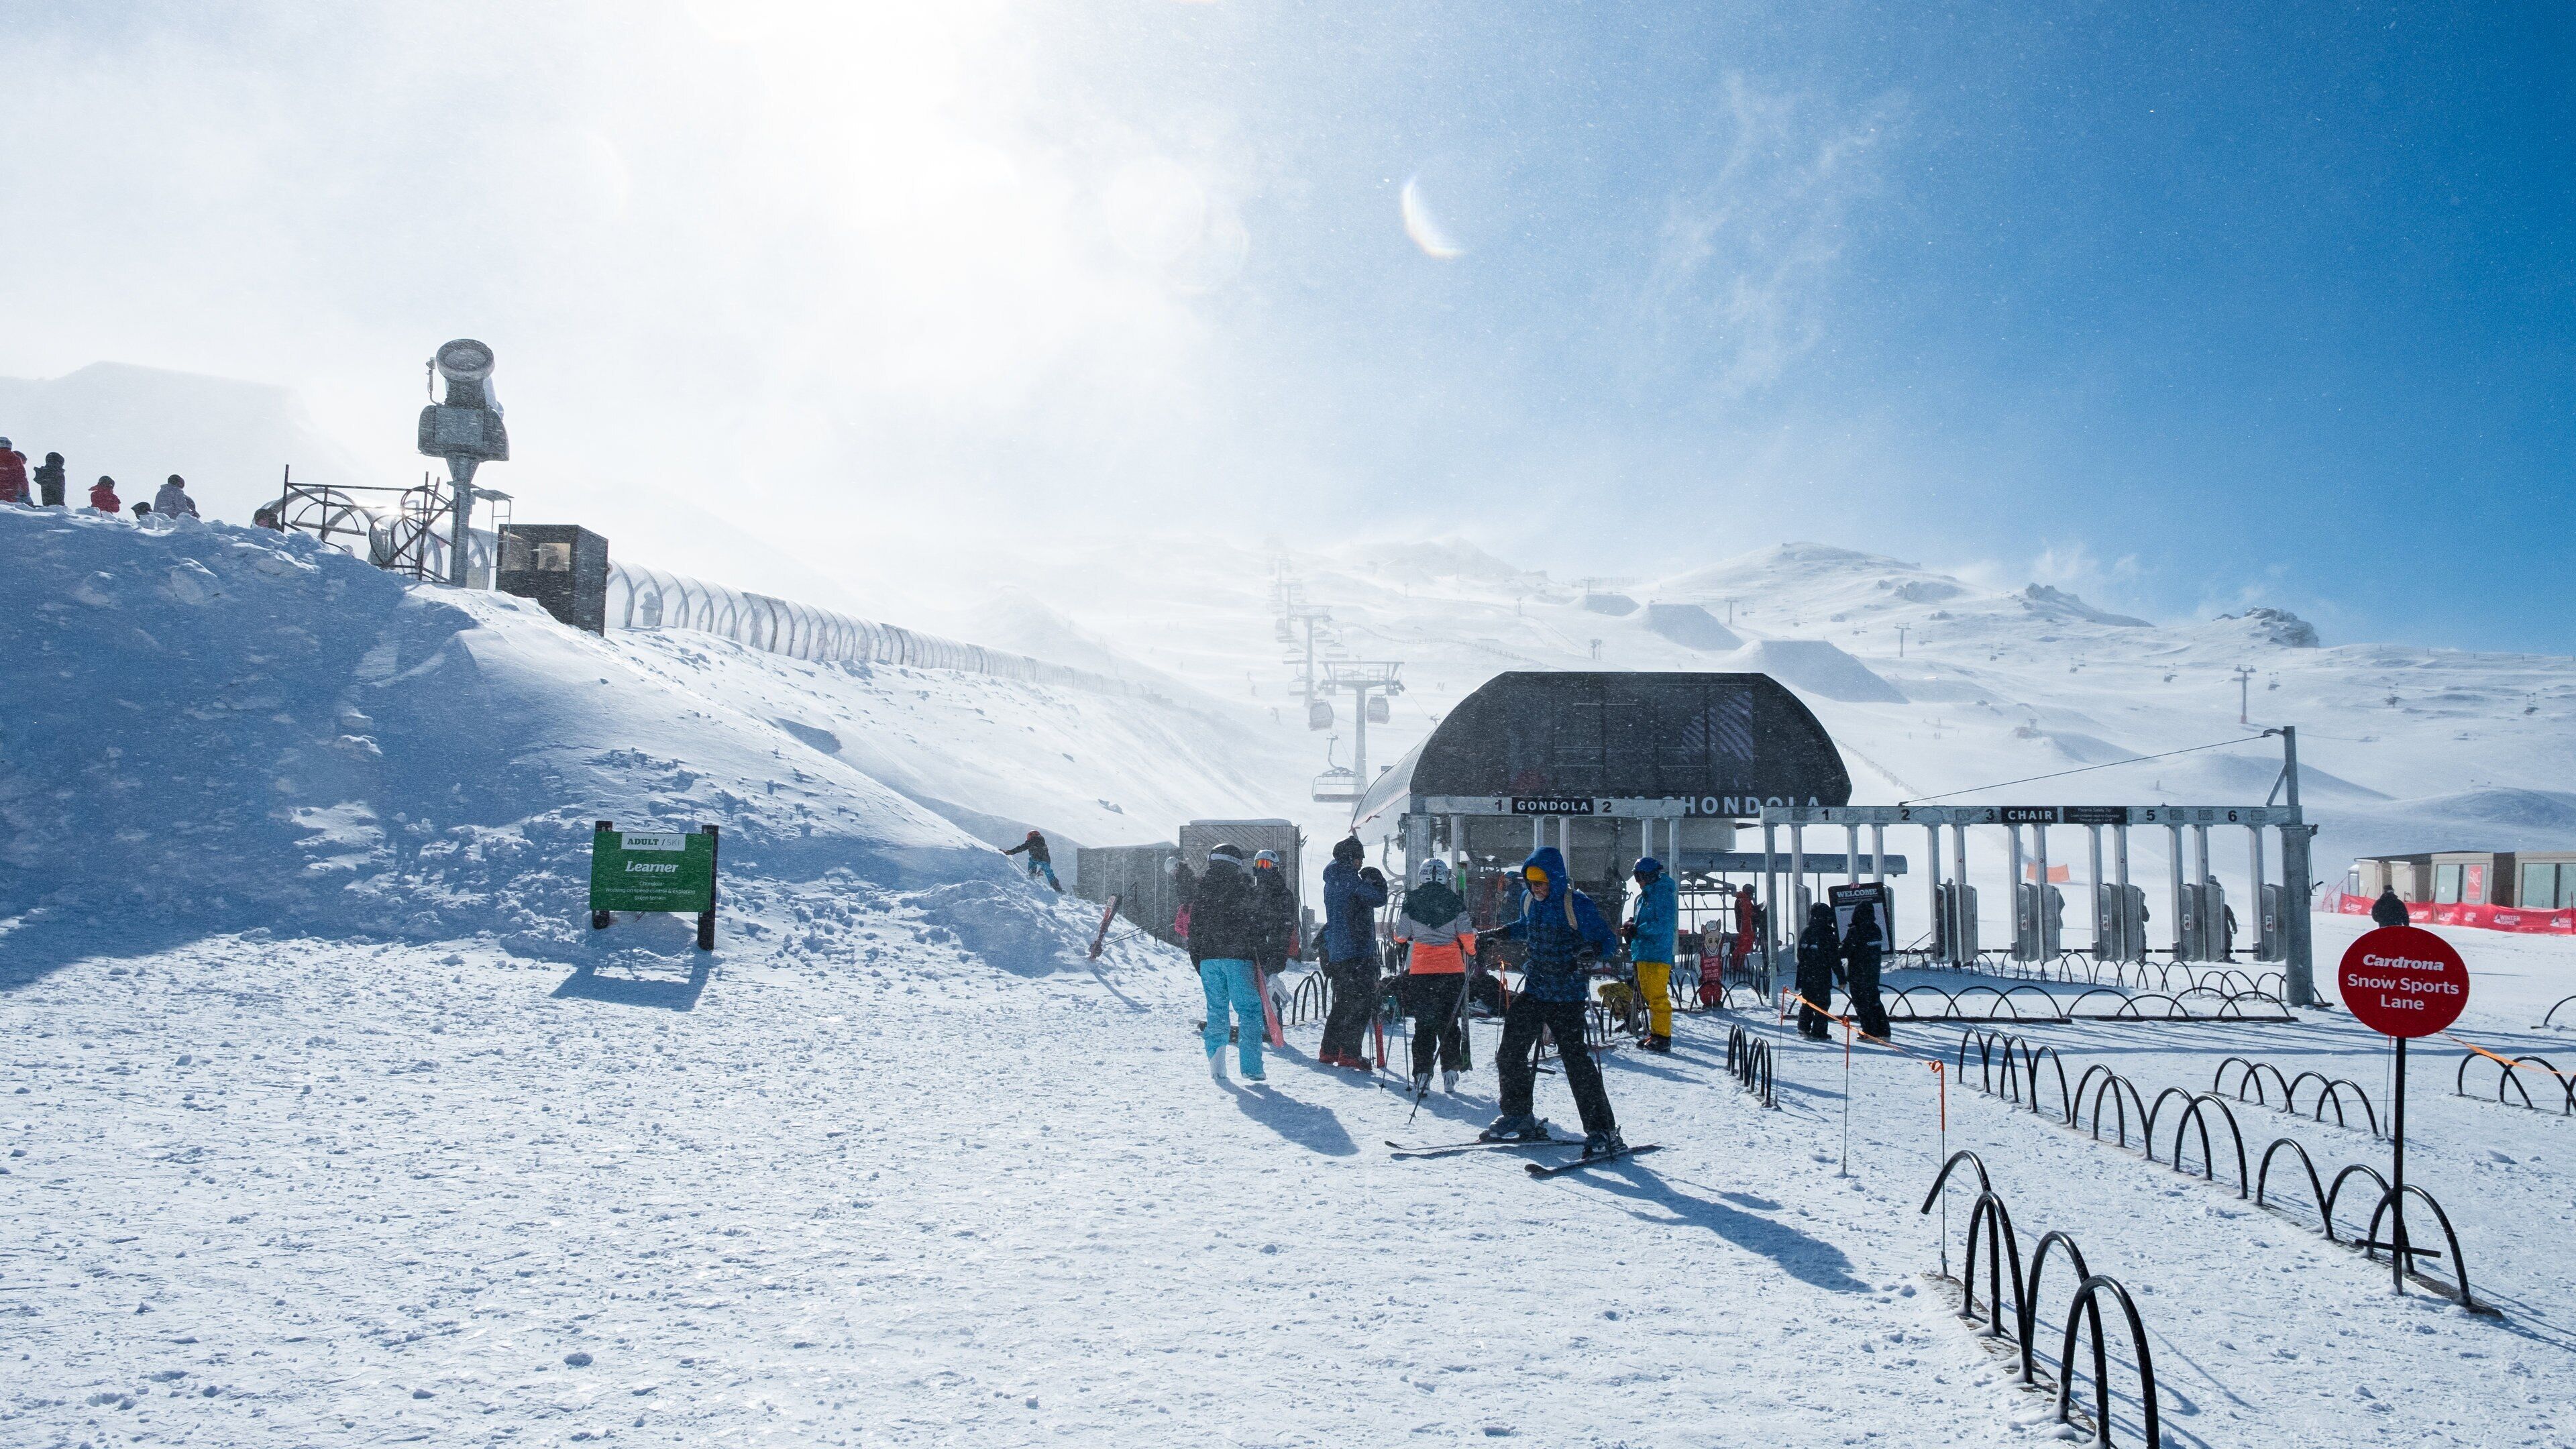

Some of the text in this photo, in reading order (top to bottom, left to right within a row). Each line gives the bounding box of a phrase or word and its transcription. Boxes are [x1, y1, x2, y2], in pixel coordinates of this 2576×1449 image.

[1495, 799, 1612, 813] 1 GONDOLA 2
[1662, 796, 1819, 814] HONDOA
[1821, 808, 2237, 822] 1 2 3 CHAIR 5 6
[627, 838, 659, 846] ADULT
[625, 861, 679, 873] Learner
[1708, 860, 1714, 868] 1
[1739, 861, 1746, 869] 2
[1837, 888, 1878, 898] WELCOME
[2363, 954, 2445, 971] Cardrona
[2347, 973, 2460, 995] Snow Sports
[2381, 994, 2424, 1010] Lane
